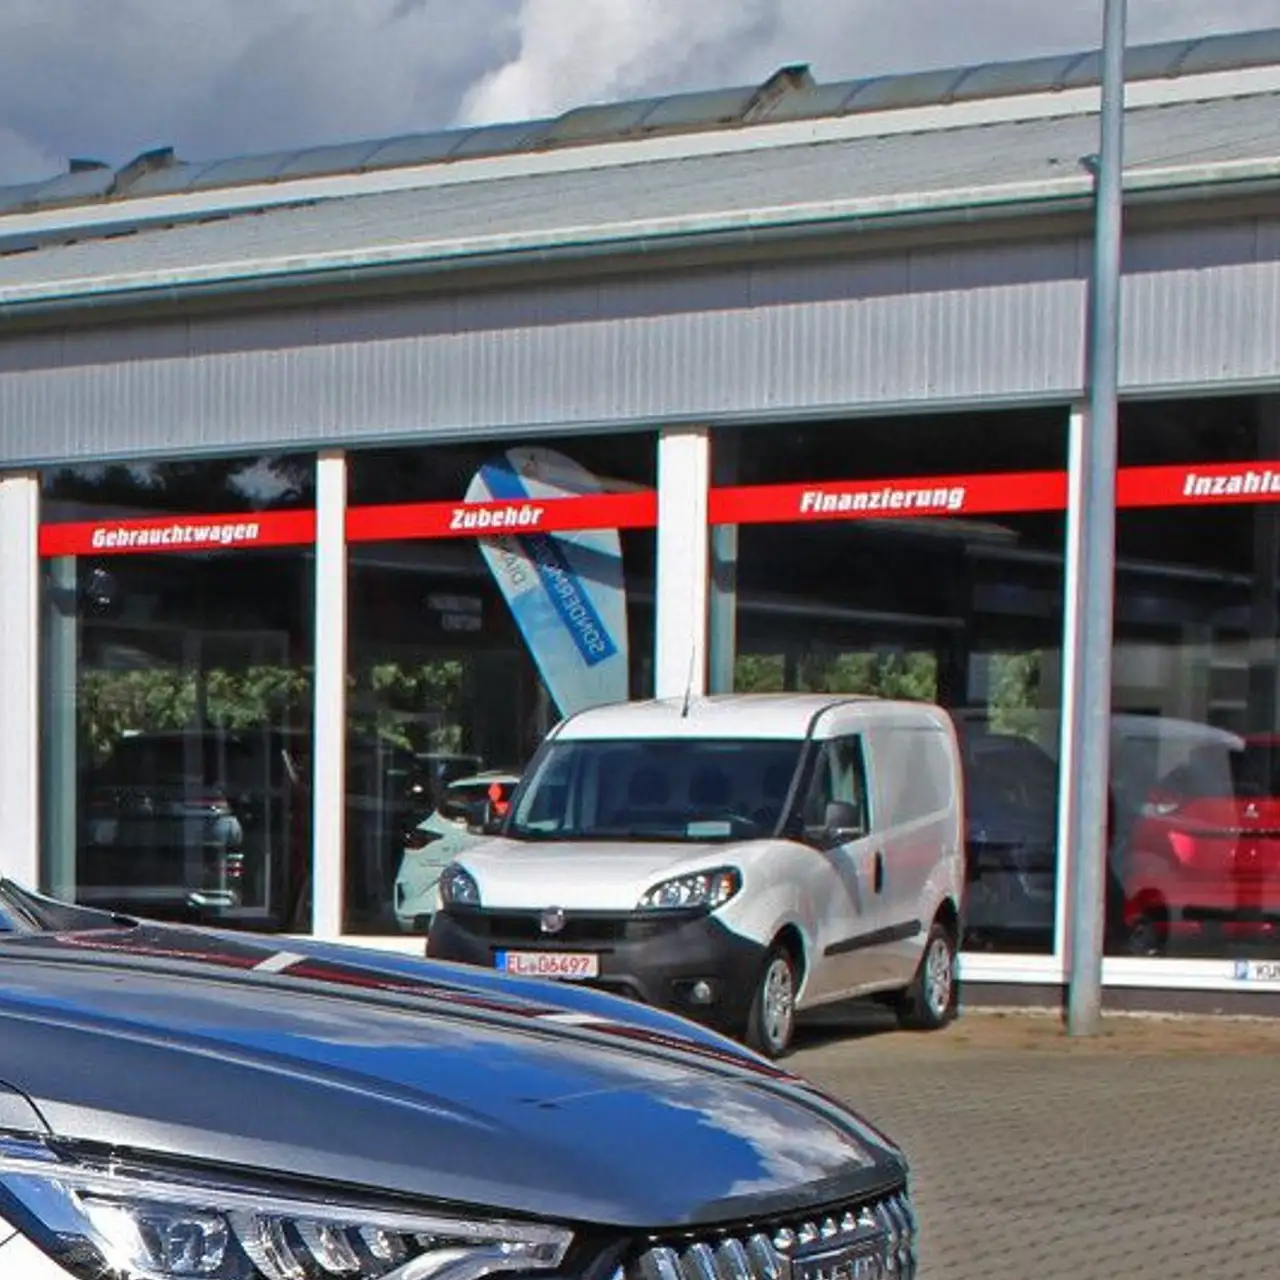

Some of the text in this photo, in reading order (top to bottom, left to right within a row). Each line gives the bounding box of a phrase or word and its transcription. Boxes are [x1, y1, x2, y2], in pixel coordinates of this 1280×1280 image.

[800, 487, 965, 513] Finanzierung
[450, 504, 544, 529] Zubehör
[92, 523, 259, 548] Gebrauchtwagen
